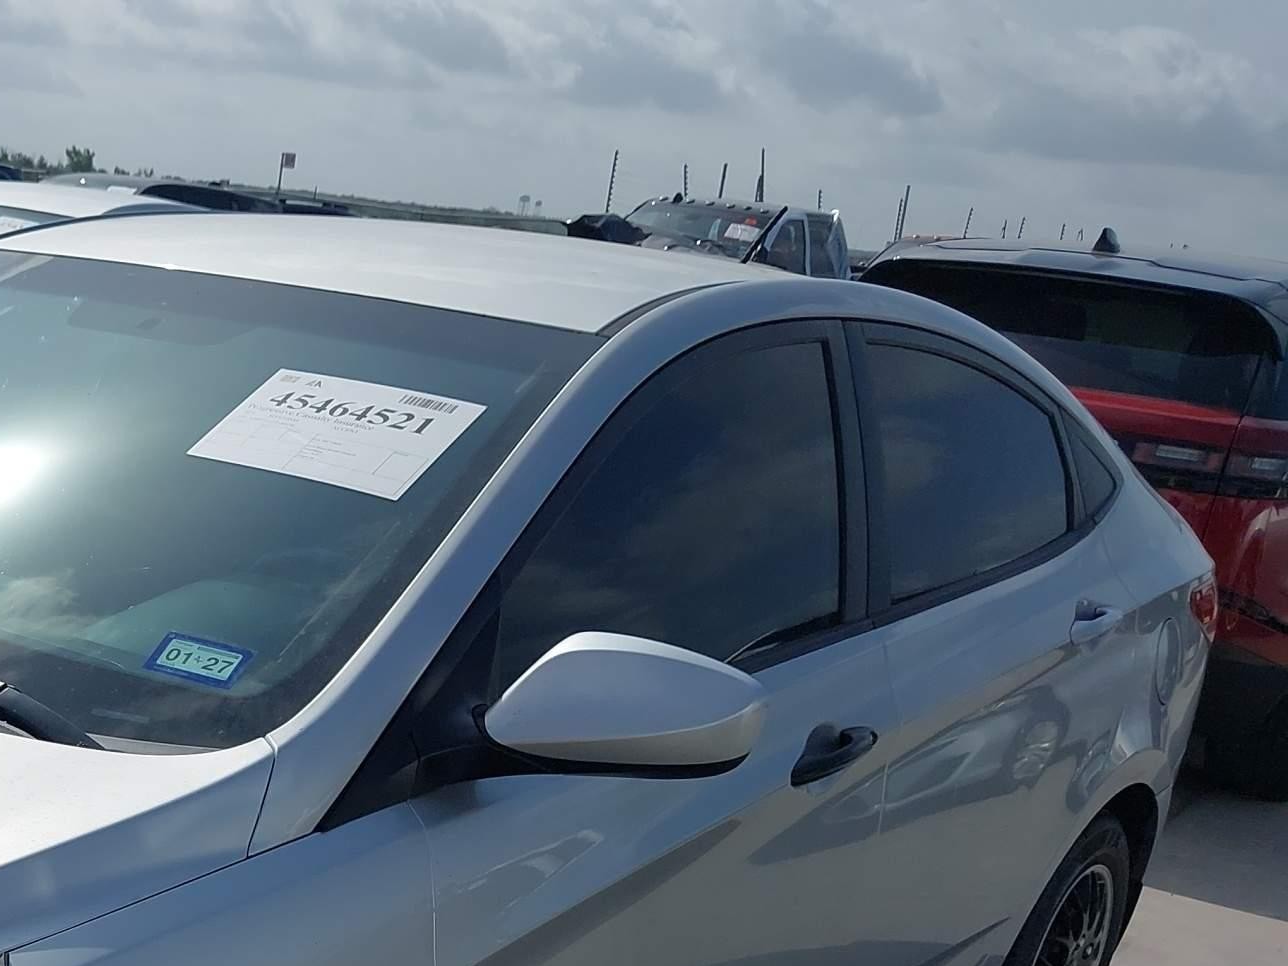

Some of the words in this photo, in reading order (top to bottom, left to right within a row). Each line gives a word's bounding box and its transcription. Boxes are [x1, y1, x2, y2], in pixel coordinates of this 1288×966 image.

[269, 391, 435, 436] 45464521
[165, 648, 193, 665] 01
[201, 657, 234, 674] 27
